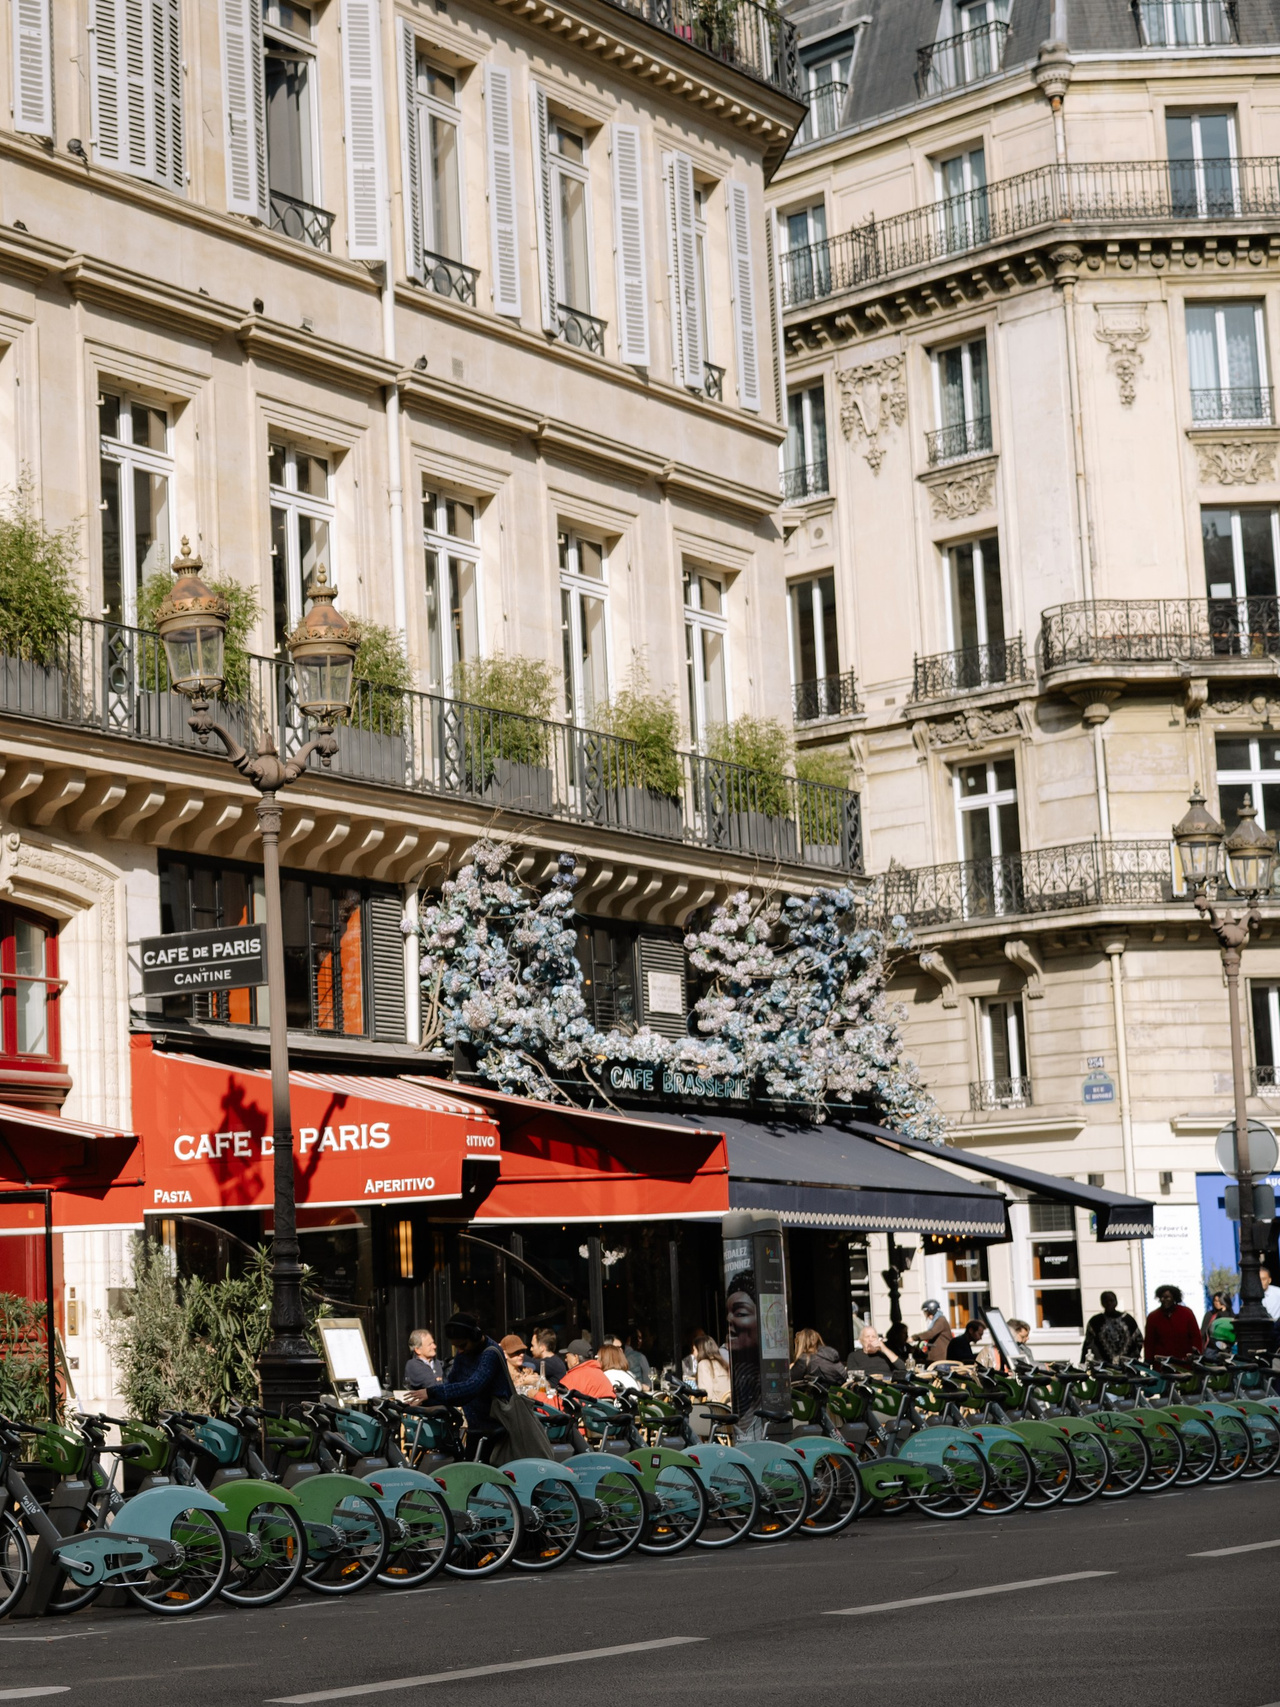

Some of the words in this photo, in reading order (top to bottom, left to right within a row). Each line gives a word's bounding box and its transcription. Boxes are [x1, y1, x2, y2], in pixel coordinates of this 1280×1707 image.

[143, 947, 190, 966] CAFE
[192, 946, 209, 958] DE
[212, 938, 262, 957] PARIS
[174, 969, 232, 985] CANTINE
[610, 1066, 654, 1091] CAFE
[662, 1072, 750, 1100] BRASSERIE
[173, 1131, 253, 1162] CAFE
[260, 1136, 275, 1156] D
[299, 1122, 391, 1154] PARIS
[153, 1189, 192, 1204] PASTA
[364, 1176, 435, 1194] APERITIVO
